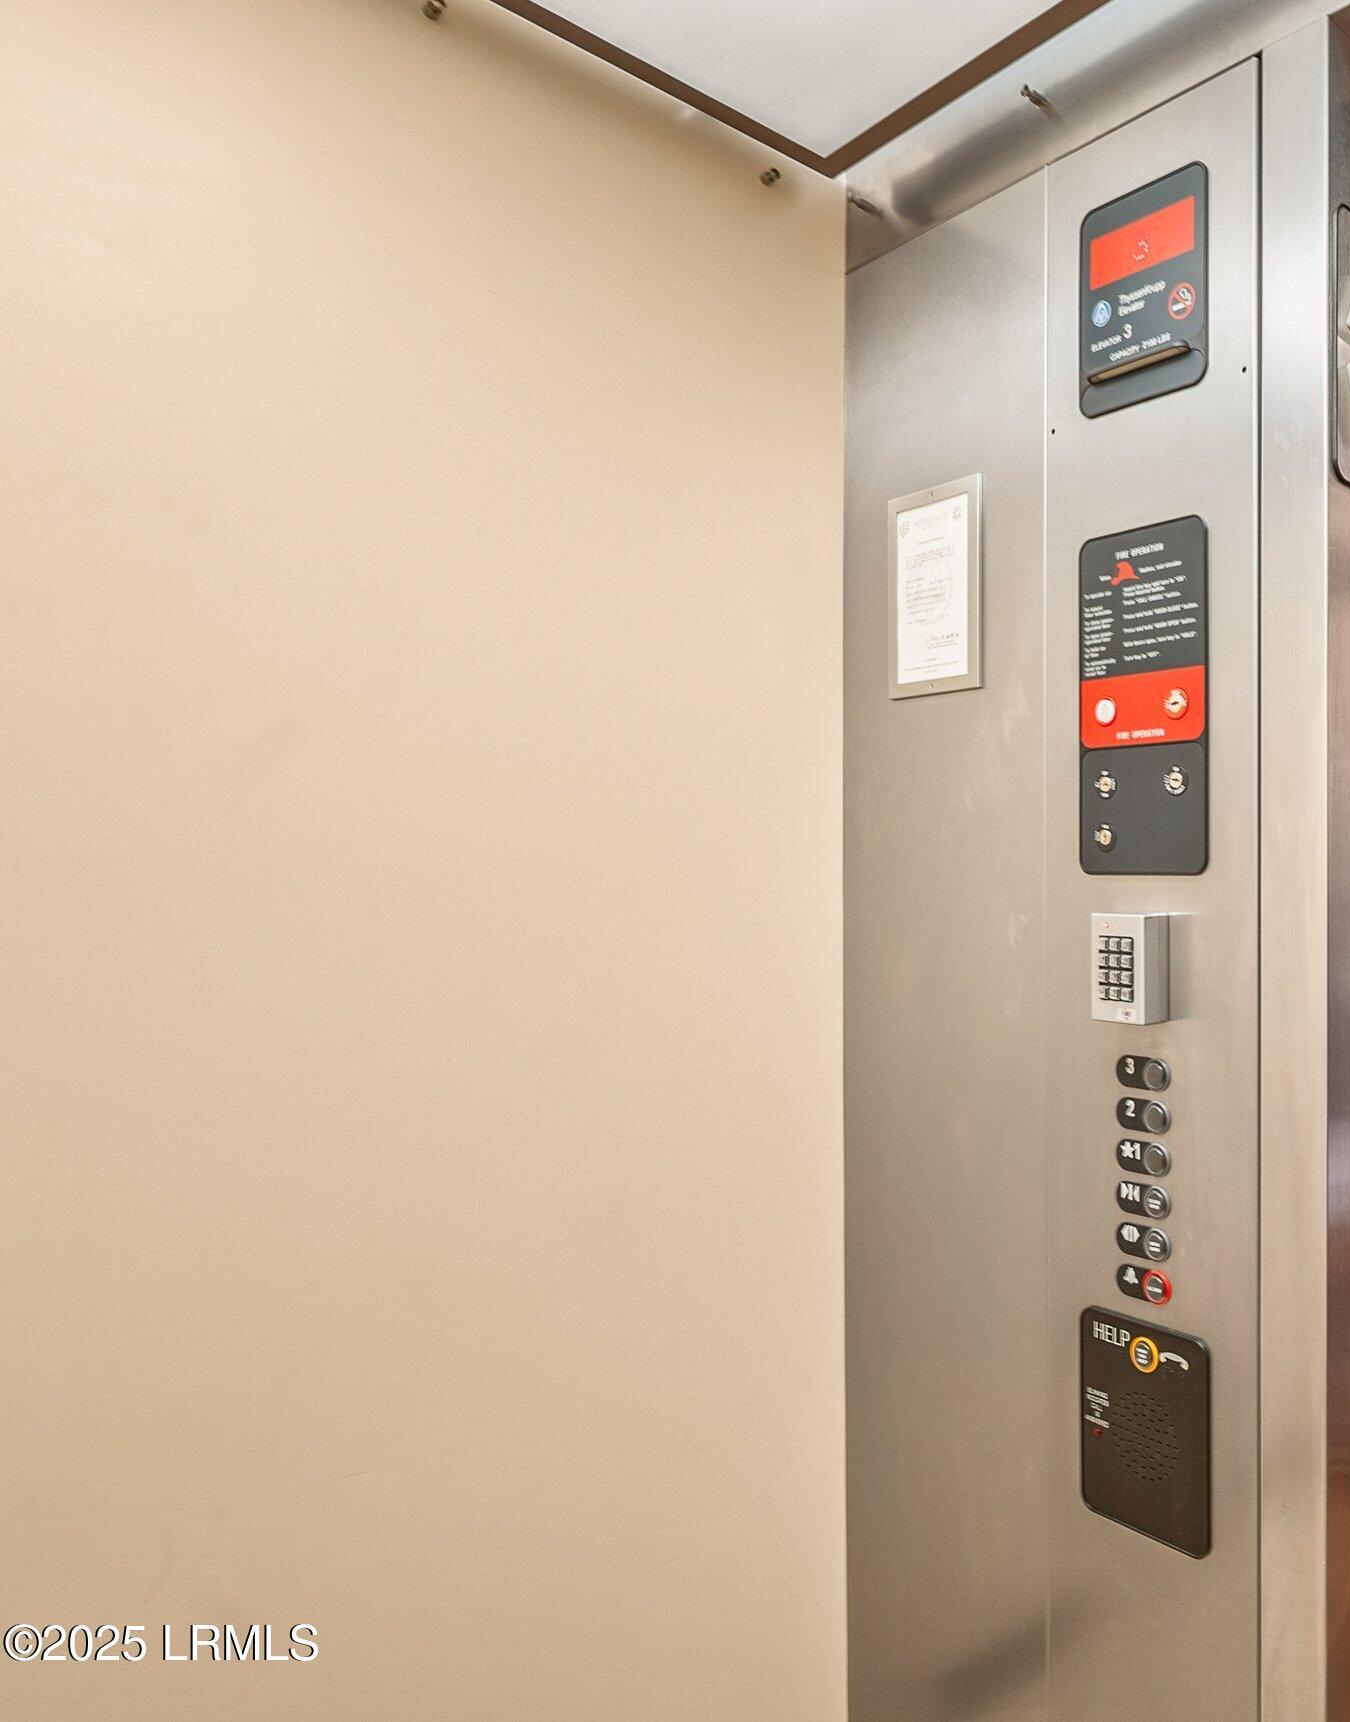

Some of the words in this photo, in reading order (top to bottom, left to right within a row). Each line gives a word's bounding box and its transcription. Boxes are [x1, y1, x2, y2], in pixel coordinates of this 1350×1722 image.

[1122, 323, 1133, 339] 3
[1115, 549, 1130, 560] FIRE
[1130, 542, 1164, 557] OPERATION
[1124, 1058, 1135, 1075] 3
[1125, 1099, 1136, 1118] 2
[1092, 1320, 1131, 1348] HELP
